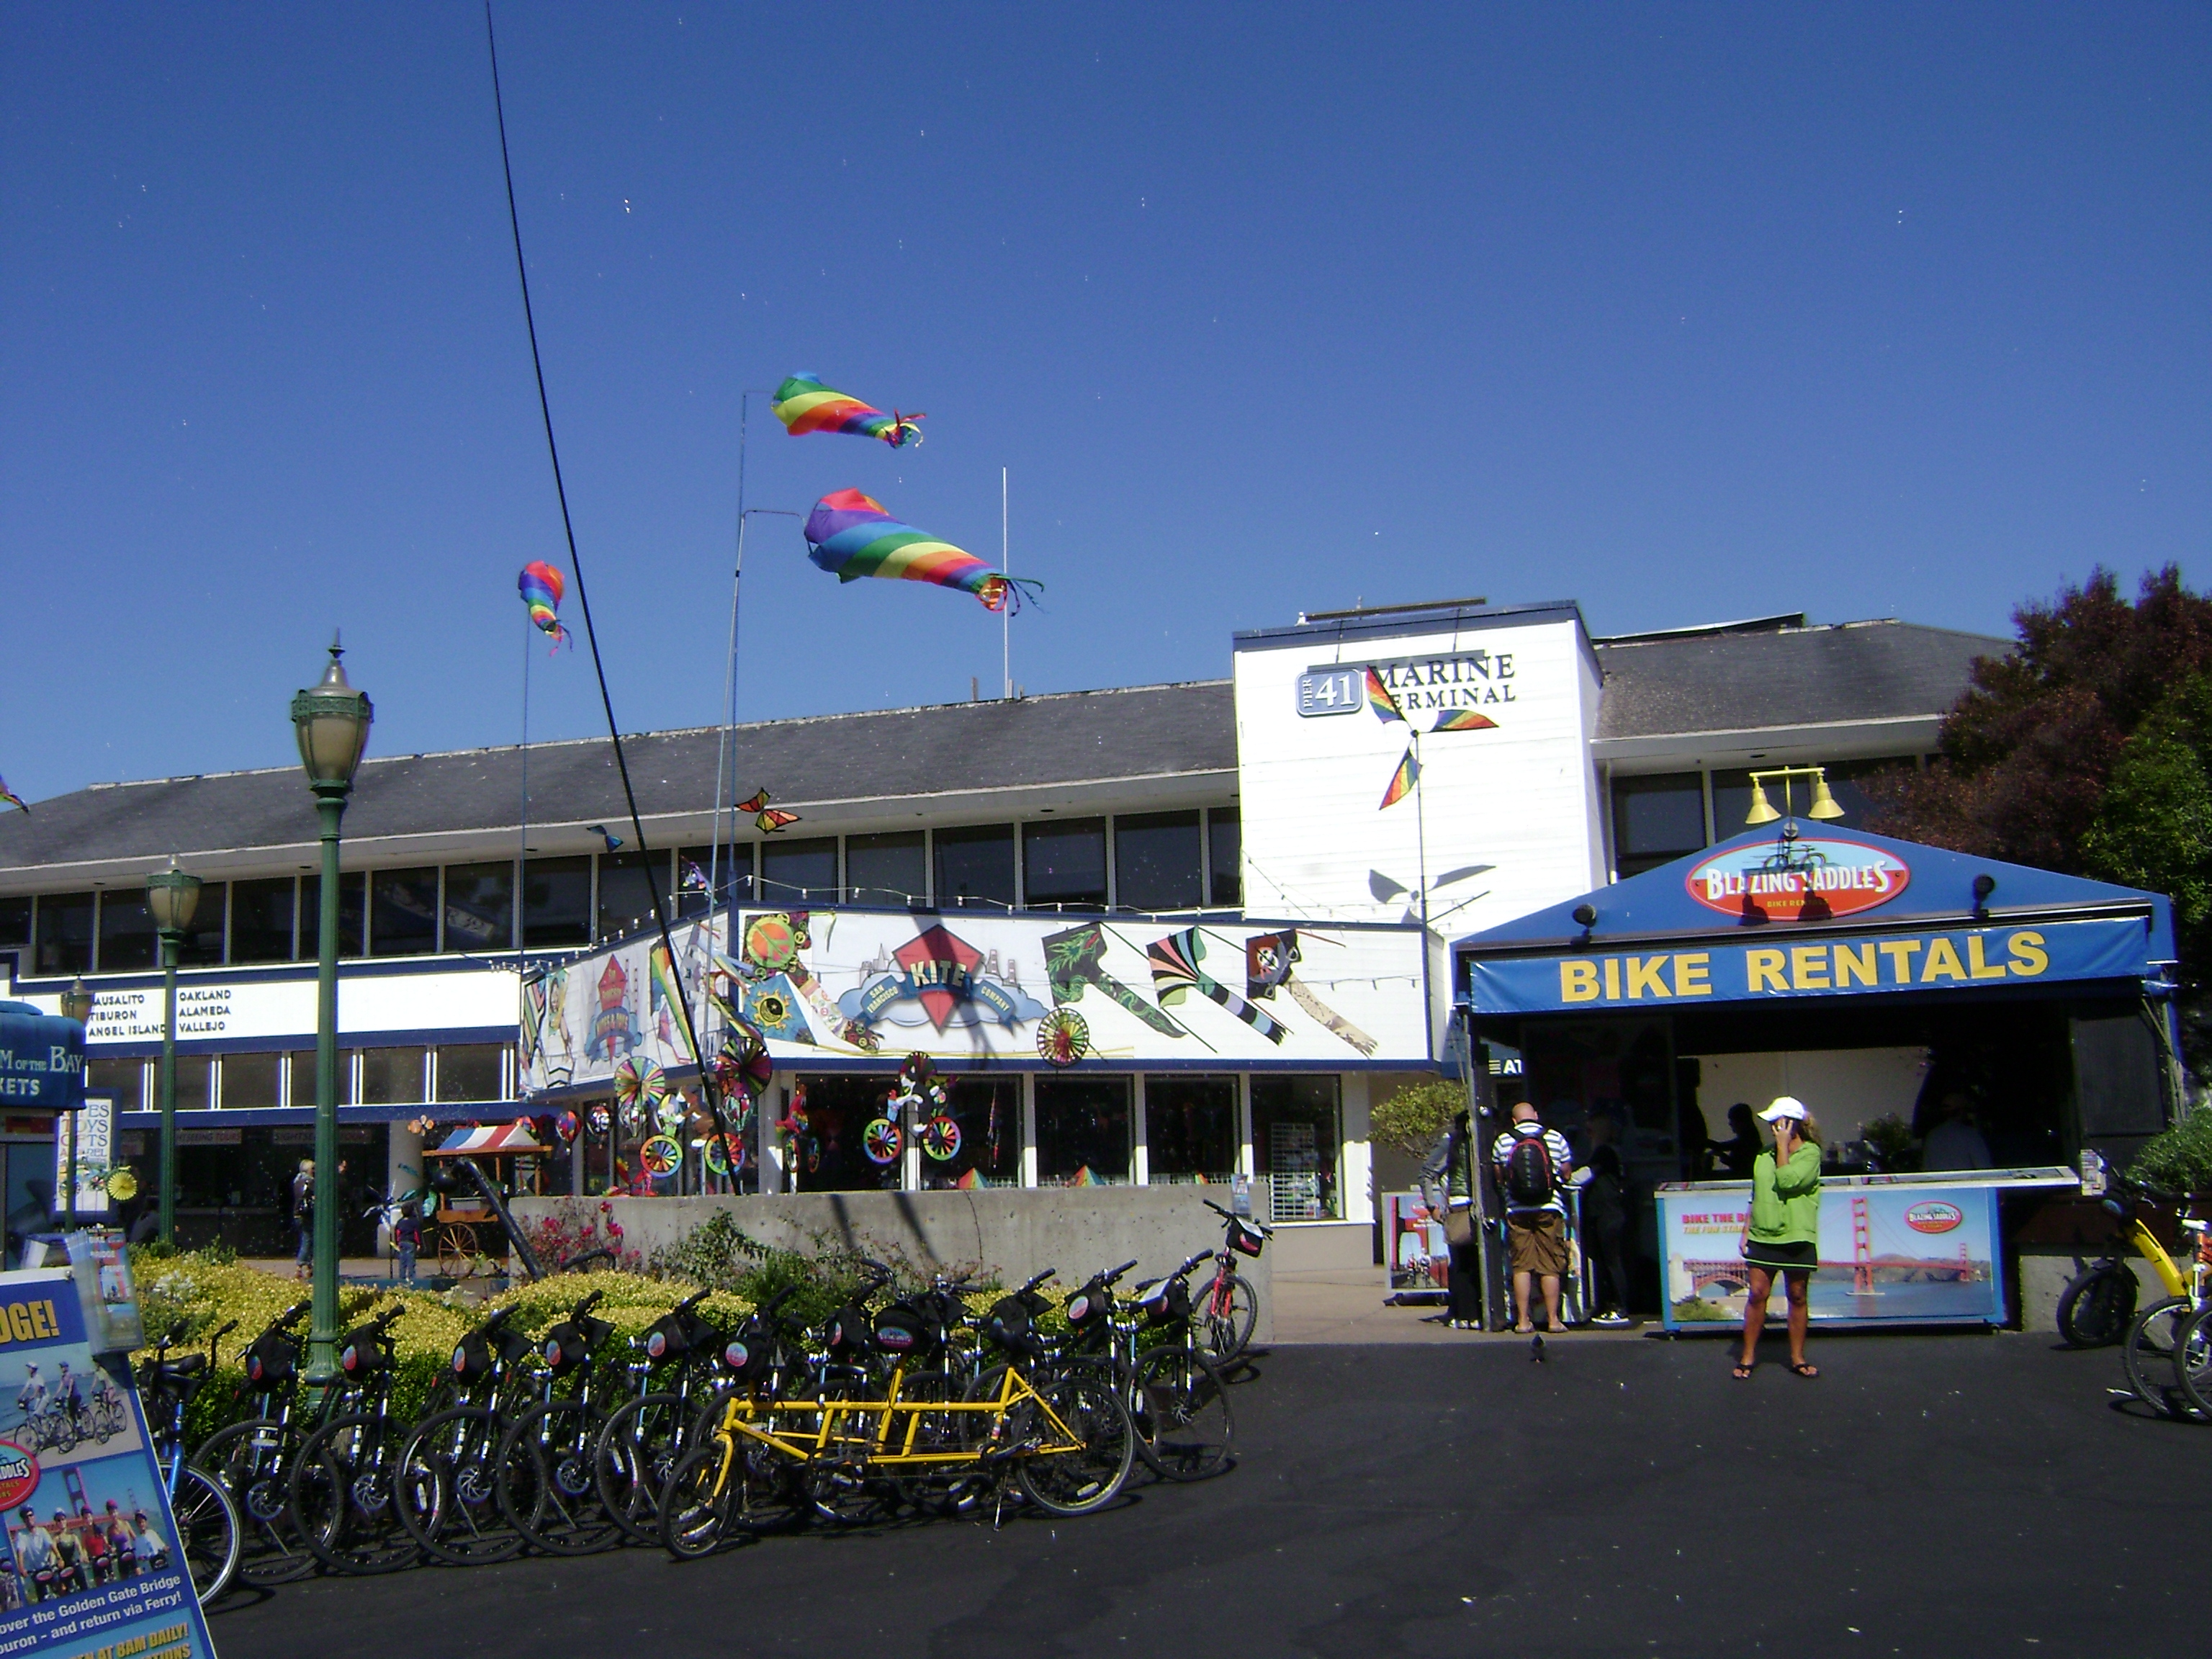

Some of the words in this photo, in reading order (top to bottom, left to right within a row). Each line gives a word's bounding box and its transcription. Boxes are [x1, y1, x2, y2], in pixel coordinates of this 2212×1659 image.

[1370, 654, 1516, 689] MARINE
[1303, 678, 1313, 709] PIER
[1315, 674, 1356, 707] 41
[1388, 685, 1516, 710] ERMINAL
[1706, 868, 1796, 900] BLAZING
[1801, 860, 1890, 893] SADDLES
[909, 960, 967, 987] KITE
[1559, 952, 1712, 1002] BIKE
[1746, 930, 2050, 992] RENTALS
[94, 994, 145, 1007] AUSALITO
[179, 989, 232, 1002] OAKLAND
[866, 985, 899, 1014] FRANCISCO
[868, 984, 885, 999] SAN
[980, 986, 1011, 1012] COMPANY
[89, 1010, 137, 1021] TIBURON
[179, 1006, 231, 1017] ALAMEDA
[89, 1026, 125, 1037] ANGEL
[128, 1023, 166, 1035] ISLAND
[179, 1021, 225, 1033] VALLEJO
[50, 1046, 84, 1073] BAY
[1681, 1213, 1709, 1223] BIKE
[1712, 1213, 1734, 1223] THE
[0, 1617, 30, 1635] over
[32, 1611, 56, 1625] the
[58, 1596, 106, 1618] Golden
[107, 1586, 138, 1604] Gate
[139, 1574, 181, 1595] Bridge
[50, 1622, 78, 1640] and
[79, 1609, 122, 1632] return
[123, 1602, 144, 1617] via
[145, 1590, 183, 1612] Ferry!
[149, 1622, 189, 1647] DAILY!
